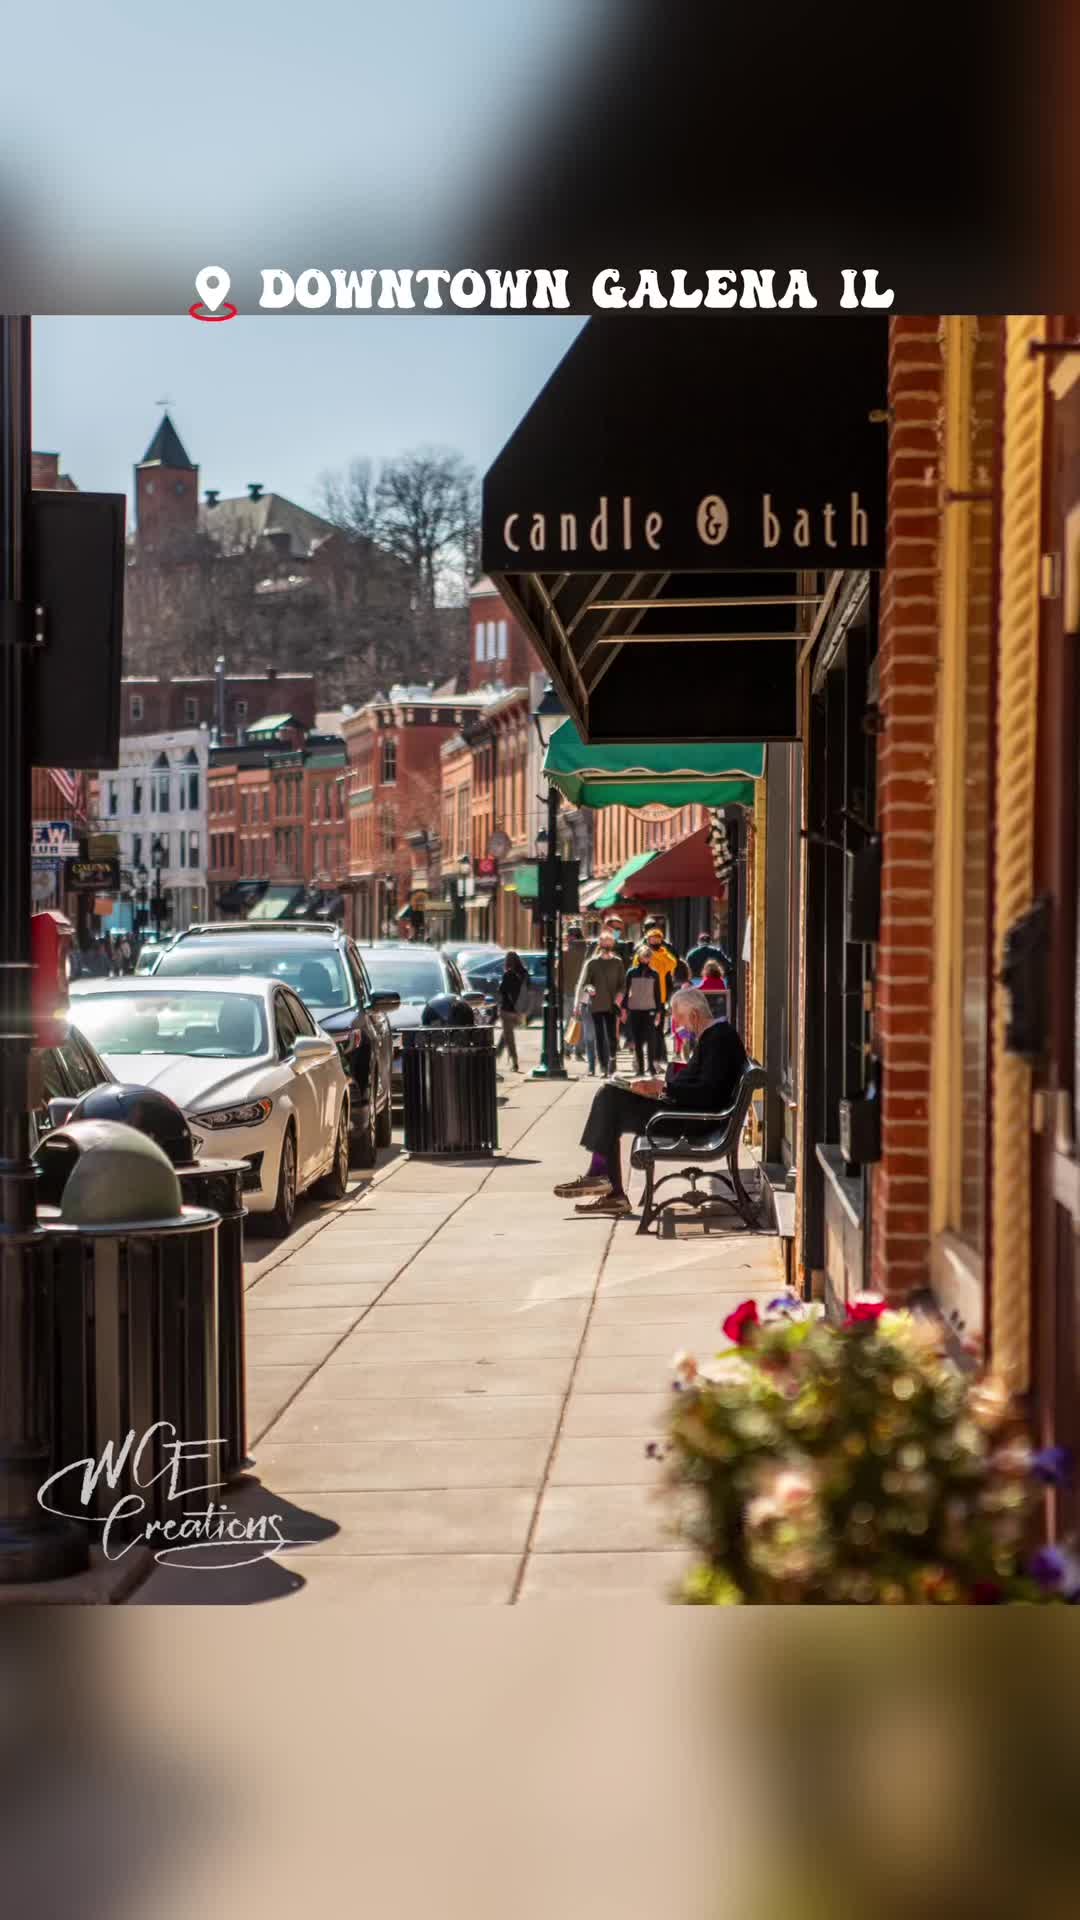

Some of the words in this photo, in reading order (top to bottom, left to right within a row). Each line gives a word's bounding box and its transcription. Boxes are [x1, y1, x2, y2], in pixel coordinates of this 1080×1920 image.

[503, 496, 664, 553] candle
[696, 494, 728, 545] &
[762, 491, 869, 549] bath
